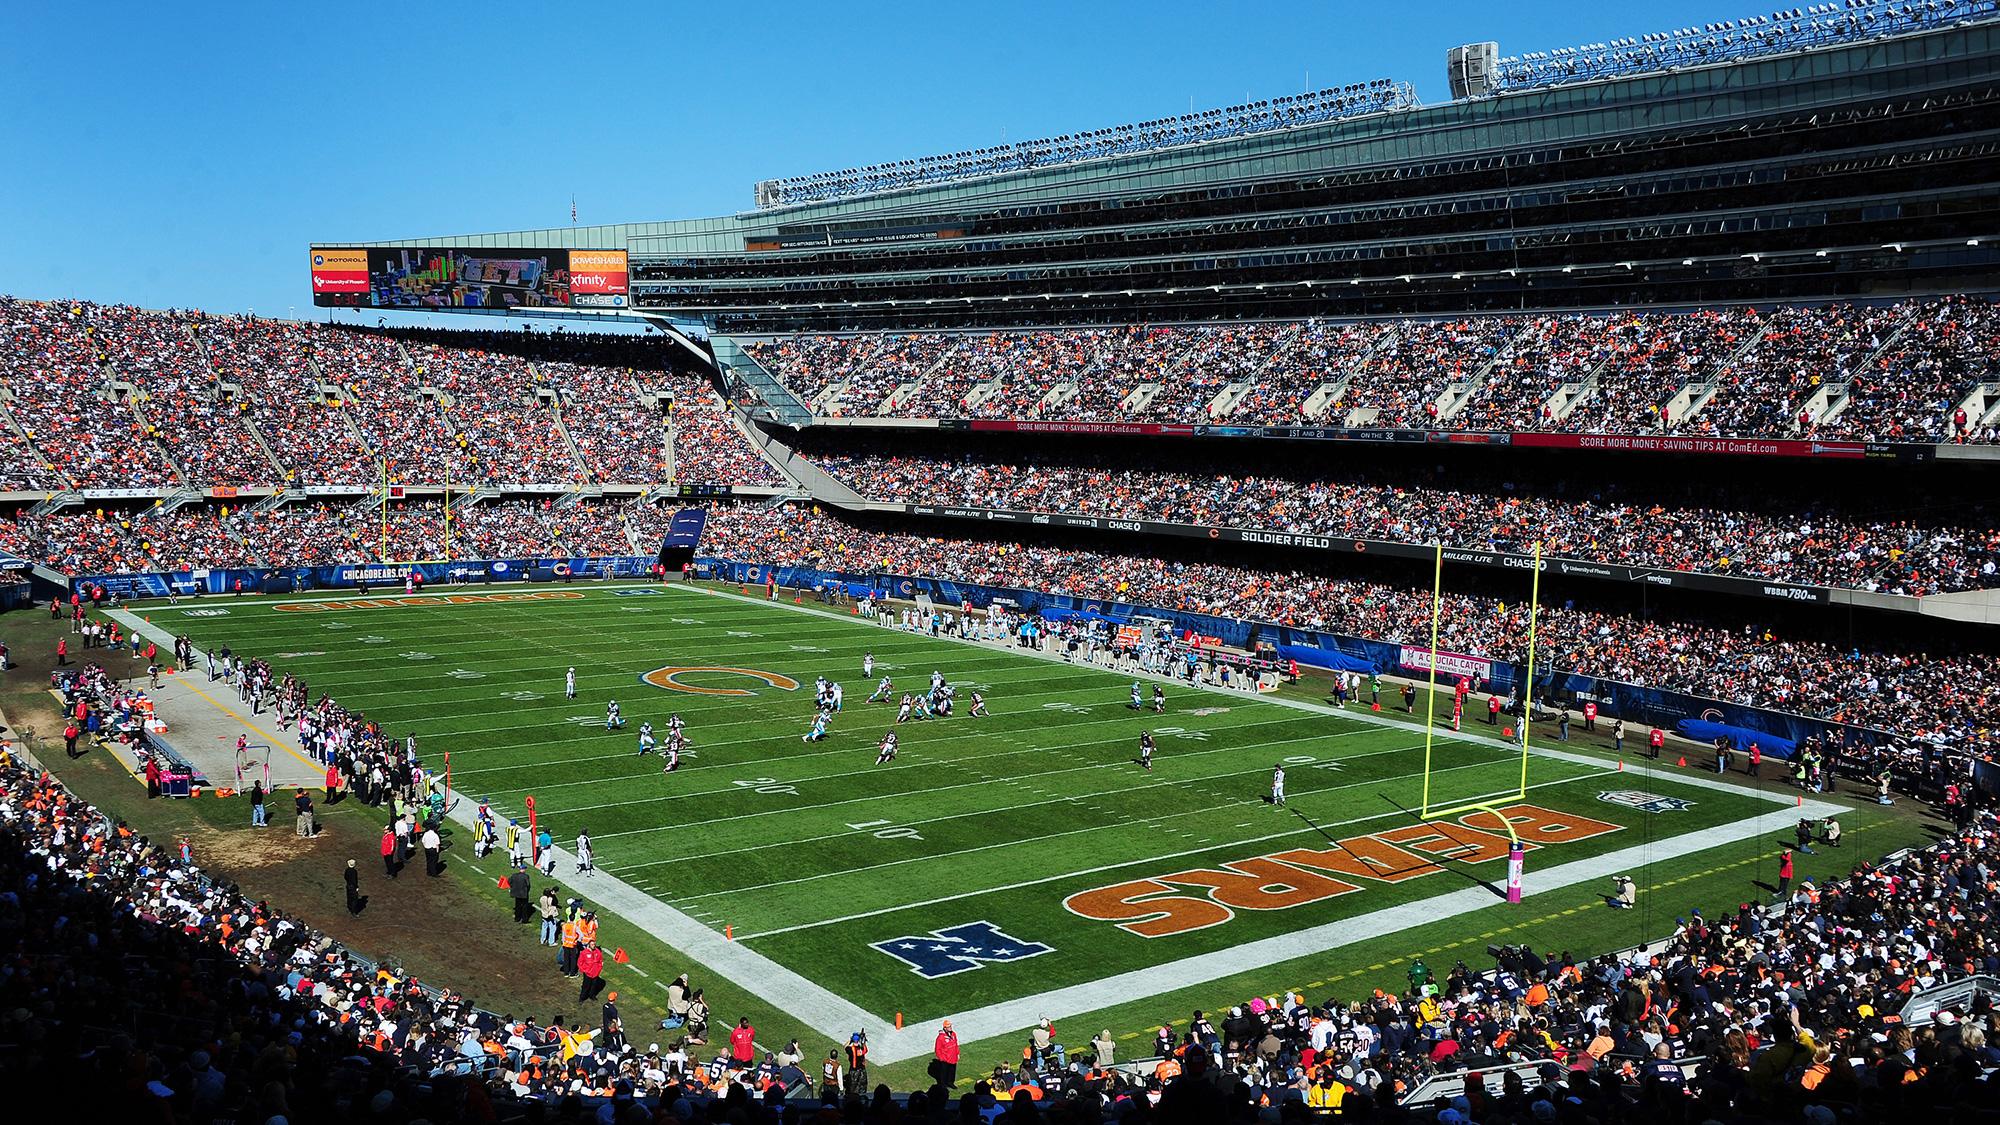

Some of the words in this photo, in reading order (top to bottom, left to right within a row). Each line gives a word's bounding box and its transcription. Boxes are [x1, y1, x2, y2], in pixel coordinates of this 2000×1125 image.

[570, 274, 607, 287] xfinity
[575, 296, 611, 305] CHASE
[1034, 423, 1049, 431] MORE
[1050, 423, 1090, 432] MONEY-SAVING
[1090, 424, 1103, 432] TIPS
[1111, 425, 1142, 433] ComEd.com
[1252, 428, 1261, 436] 20
[1316, 430, 1325, 438] 20
[1386, 432, 1394, 440] 32
[1500, 435, 1510, 444] 24
[1580, 437, 1605, 447] SCORE
[1607, 438, 1630, 448] MORE
[1632, 439, 1693, 450] MONEY-SAVING
[1695, 440, 1714, 451] TIPS
[1716, 441, 1727, 451] AT
[1728, 442, 1778, 453] ComEd.com
[1108, 521, 1133, 530] CHASE
[1241, 532, 1292, 545] SOLDIER
[1294, 537, 1330, 549] FIELD
[1442, 552, 1473, 561] MILLER
[1474, 555, 1494, 563] LITE
[1503, 557, 1536, 569] CHASE
[1647, 575, 1672, 585] verizon
[1764, 586, 1788, 597] WBBM
[1788, 588, 1808, 600] 780
[1419, 653, 1424, 661] A
[1426, 654, 1458, 668] CUCIAL
[1460, 661, 1485, 672] CATCH
[732, 777, 796, 795] 20
[845, 818, 919, 839] 10
[1061, 804, 1627, 938] BEARS
[1299, 1016, 1310, 1032] 90
[1340, 1040, 1354, 1053] 54
